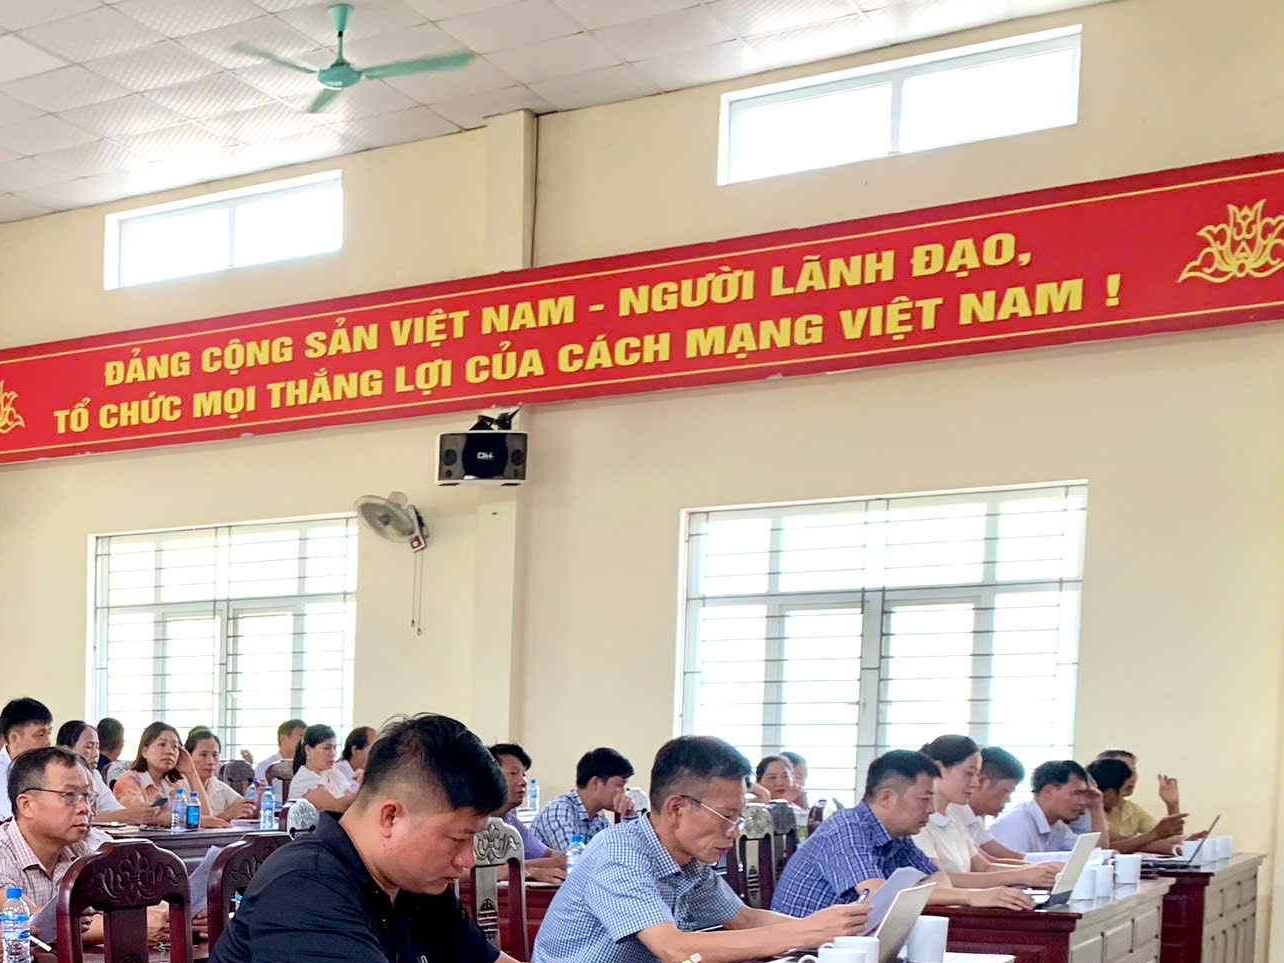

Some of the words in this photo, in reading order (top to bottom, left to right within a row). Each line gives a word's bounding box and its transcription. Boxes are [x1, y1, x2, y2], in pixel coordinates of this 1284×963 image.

[53, 397, 91, 434] TỔ
[99, 394, 182, 429] CHỨC
[192, 385, 256, 420] MỌI
[266, 366, 383, 409] THẮNG
[395, 358, 453, 398] LỢI
[465, 340, 545, 384] CỦA
[558, 332, 671, 373] CÁCH
[685, 314, 824, 360] MẠNG
[839, 295, 945, 341] VIỆT
[959, 278, 1084, 325] NAM
[1105, 273, 1121, 307] !
[103, 345, 191, 386] ĐẢNG
[201, 337, 293, 375] CỘNG
[304, 316, 378, 359] SẢN
[390, 307, 470, 348] VIỆT
[481, 295, 575, 335] NAM
[619, 269, 755, 317] NGƯỜI
[771, 250, 895, 297] LÃNH
[910, 233, 1031, 278] ĐẠO,
